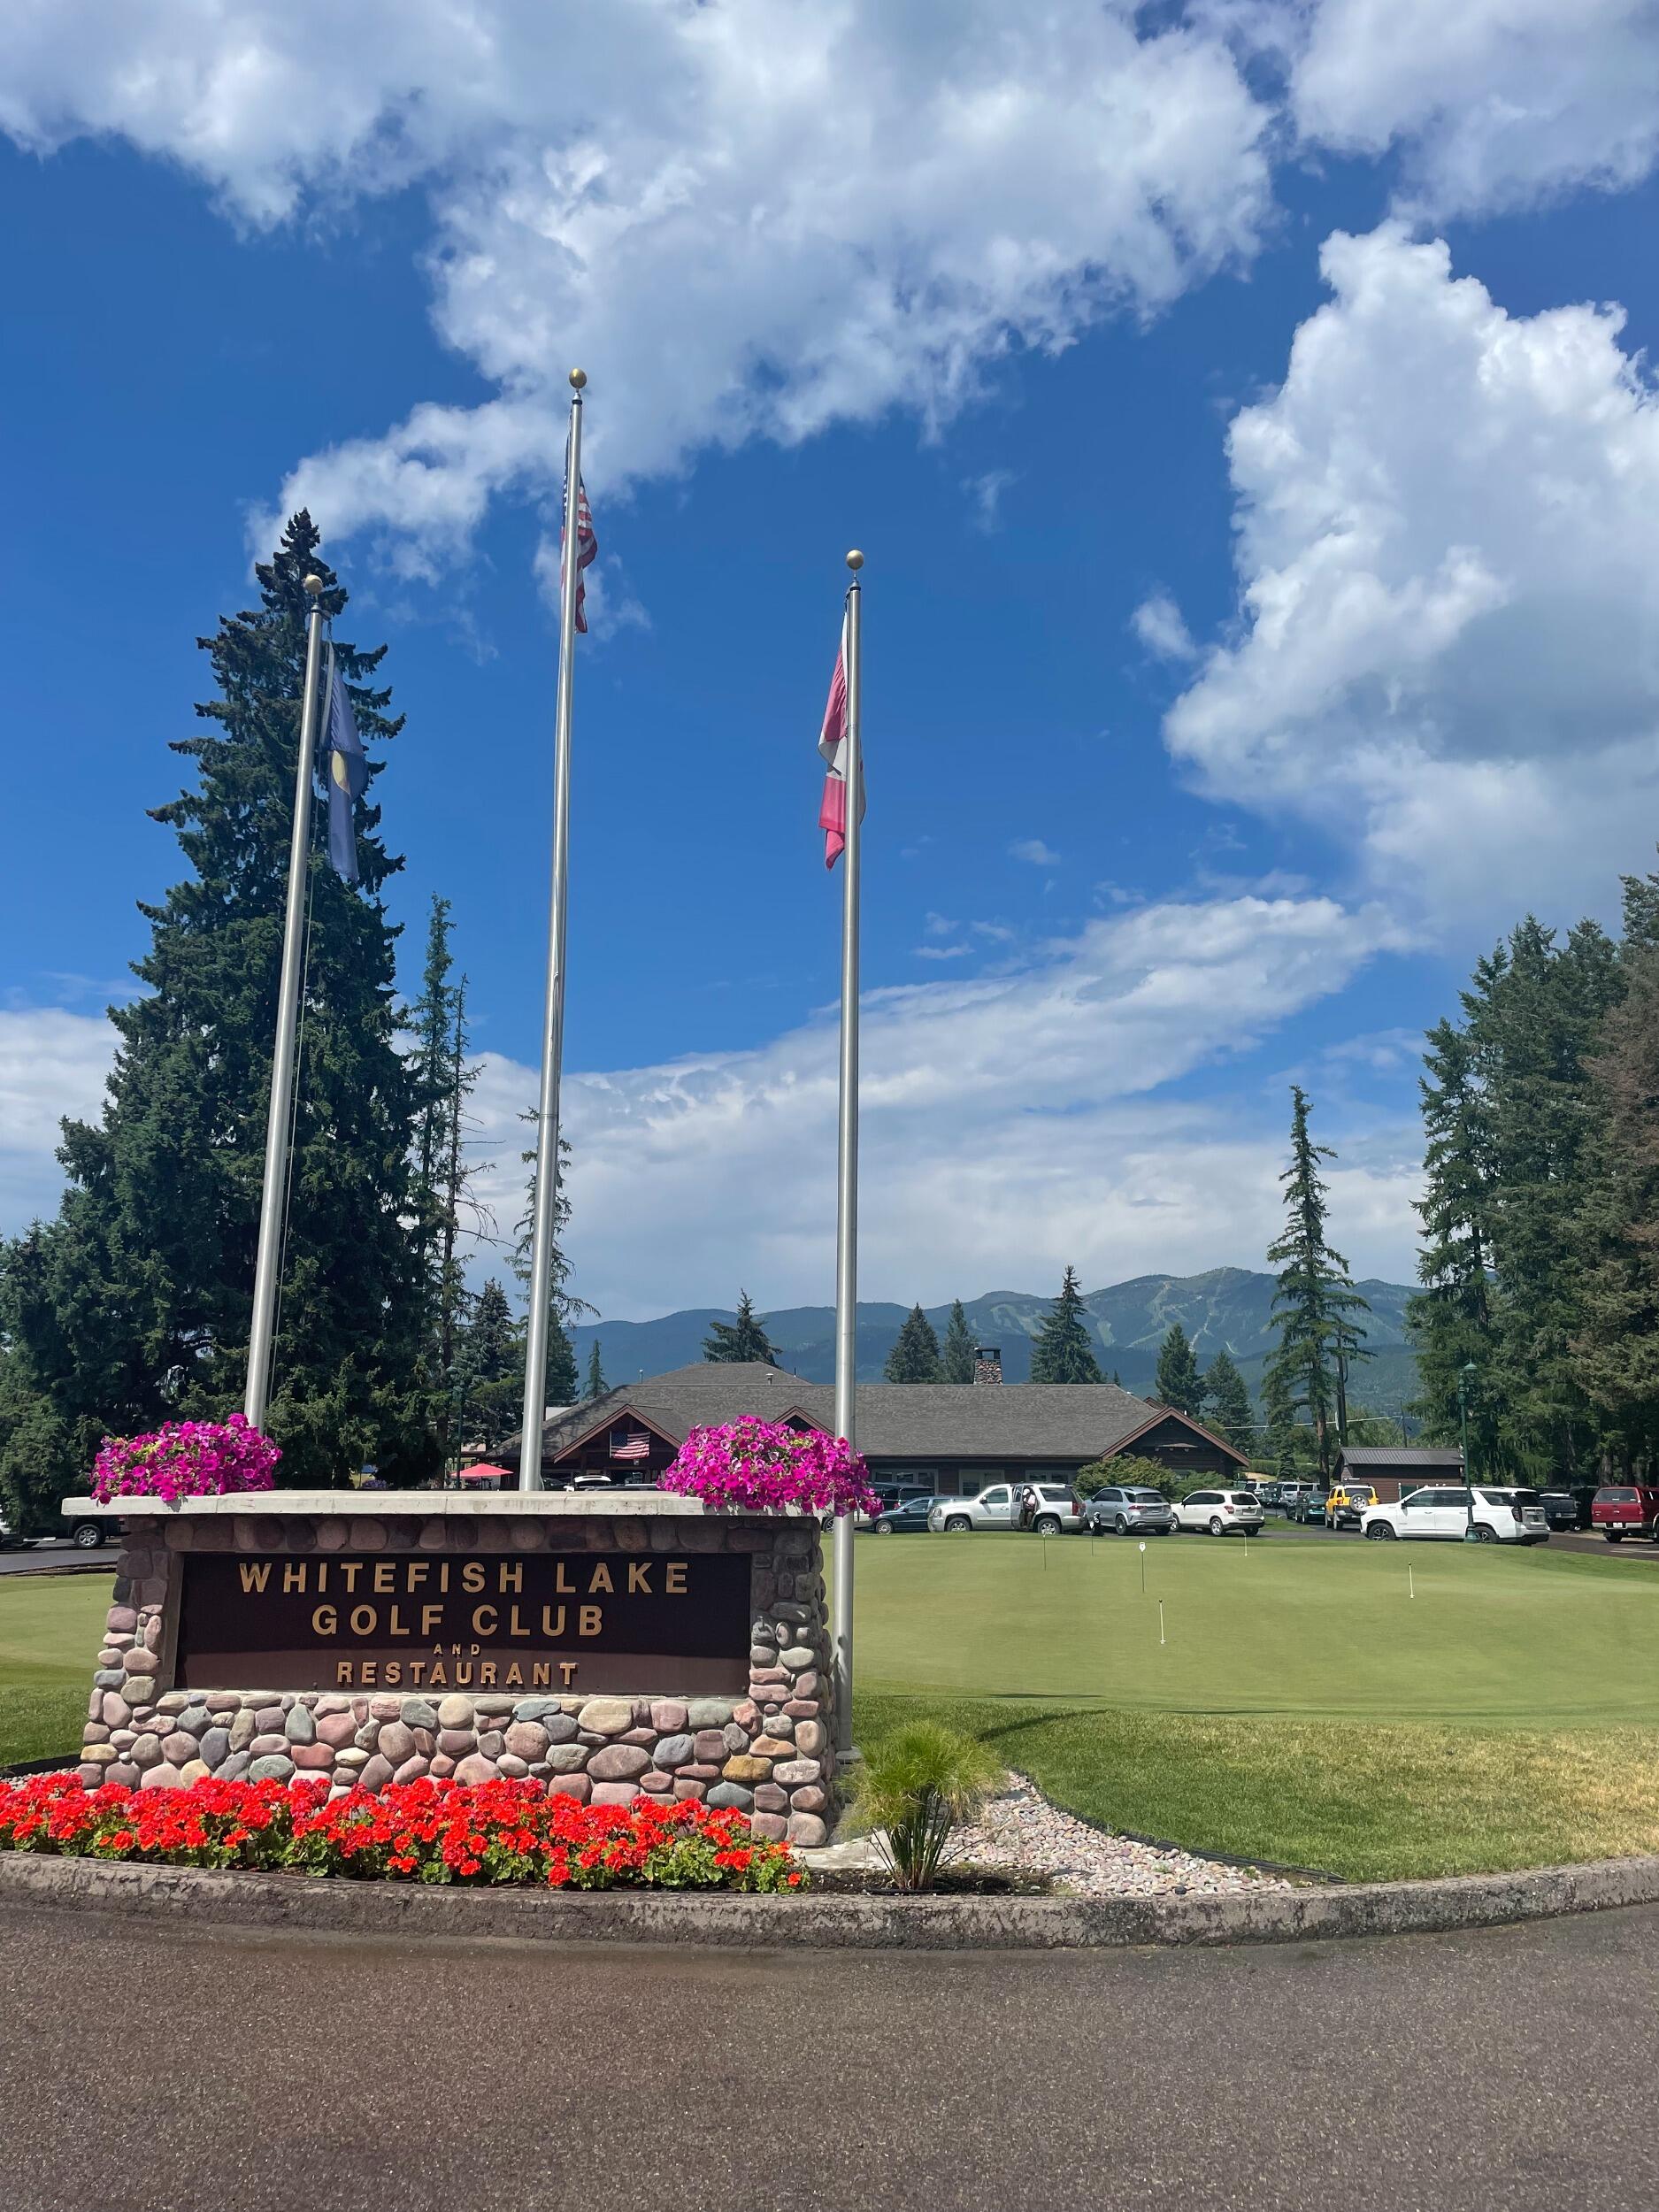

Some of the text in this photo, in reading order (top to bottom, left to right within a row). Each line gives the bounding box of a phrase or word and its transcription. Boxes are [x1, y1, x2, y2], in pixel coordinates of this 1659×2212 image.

[239, 1563, 688, 1594] WHITEFISH LAKE
[311, 1605, 603, 1636] GOLF CLUB
[433, 1643, 480, 1655] AND
[337, 1662, 577, 1685] RESTAURANT
